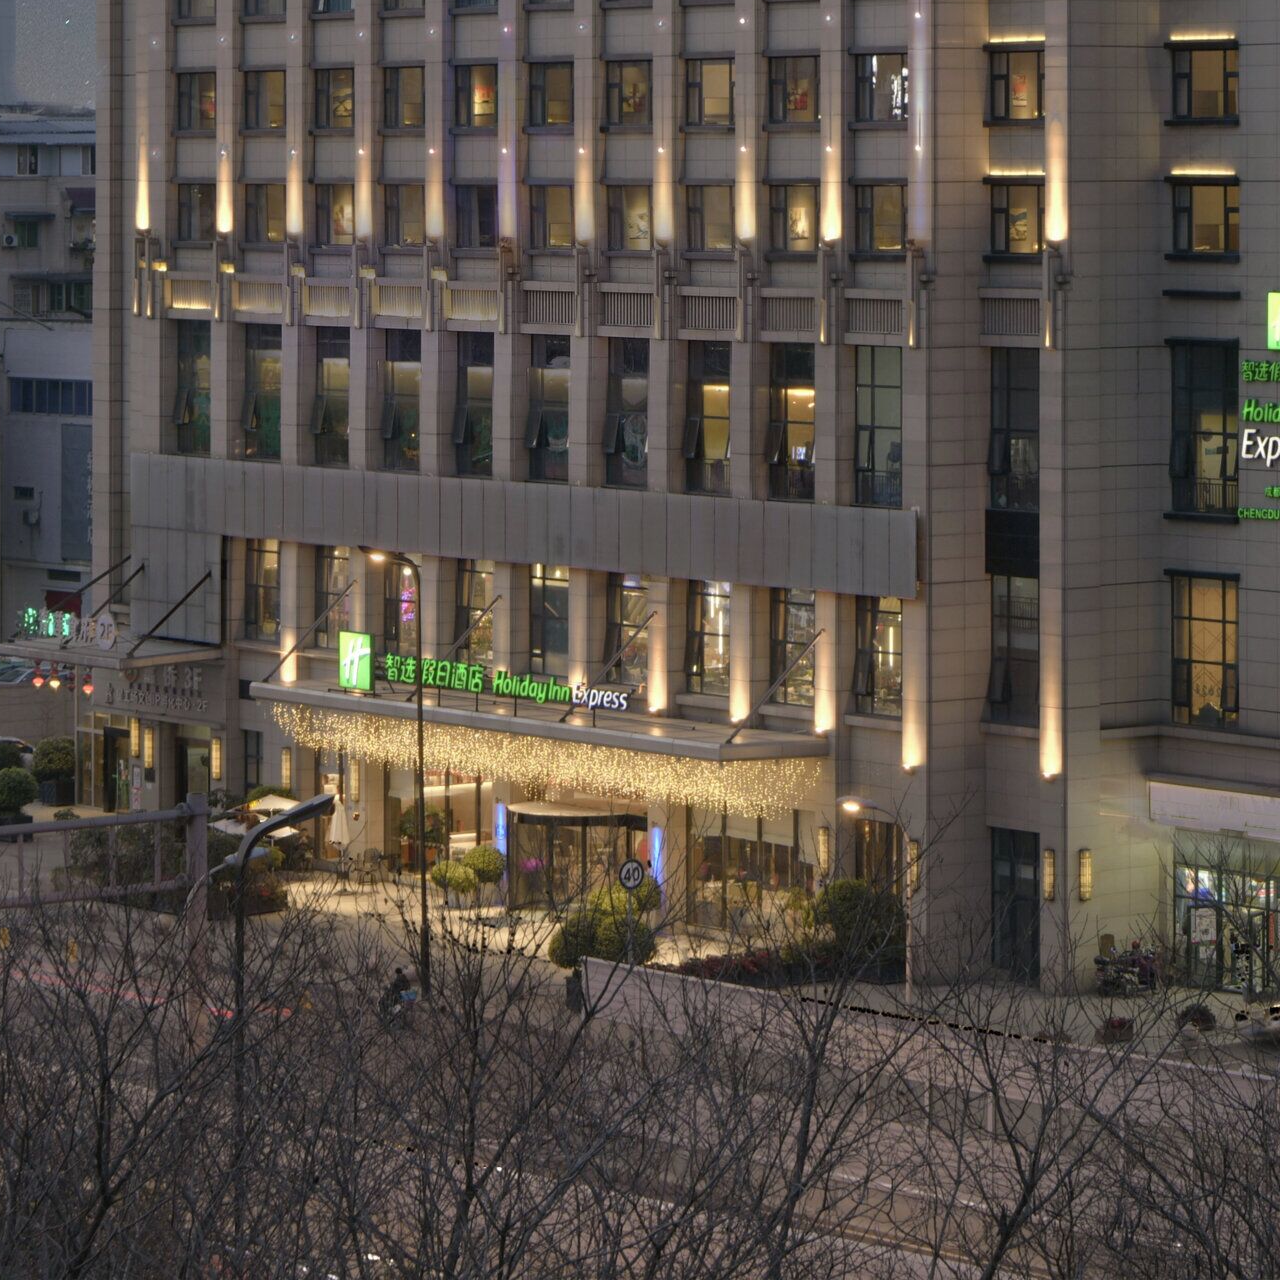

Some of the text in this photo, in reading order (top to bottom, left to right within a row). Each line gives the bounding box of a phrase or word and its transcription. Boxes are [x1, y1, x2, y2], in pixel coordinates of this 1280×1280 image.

[1237, 507, 1280, 520] CHENGDU
[384, 652, 484, 693] 智选假日酒店
[493, 670, 629, 710] Holiday Inn Express
[624, 867, 641, 882] 40
